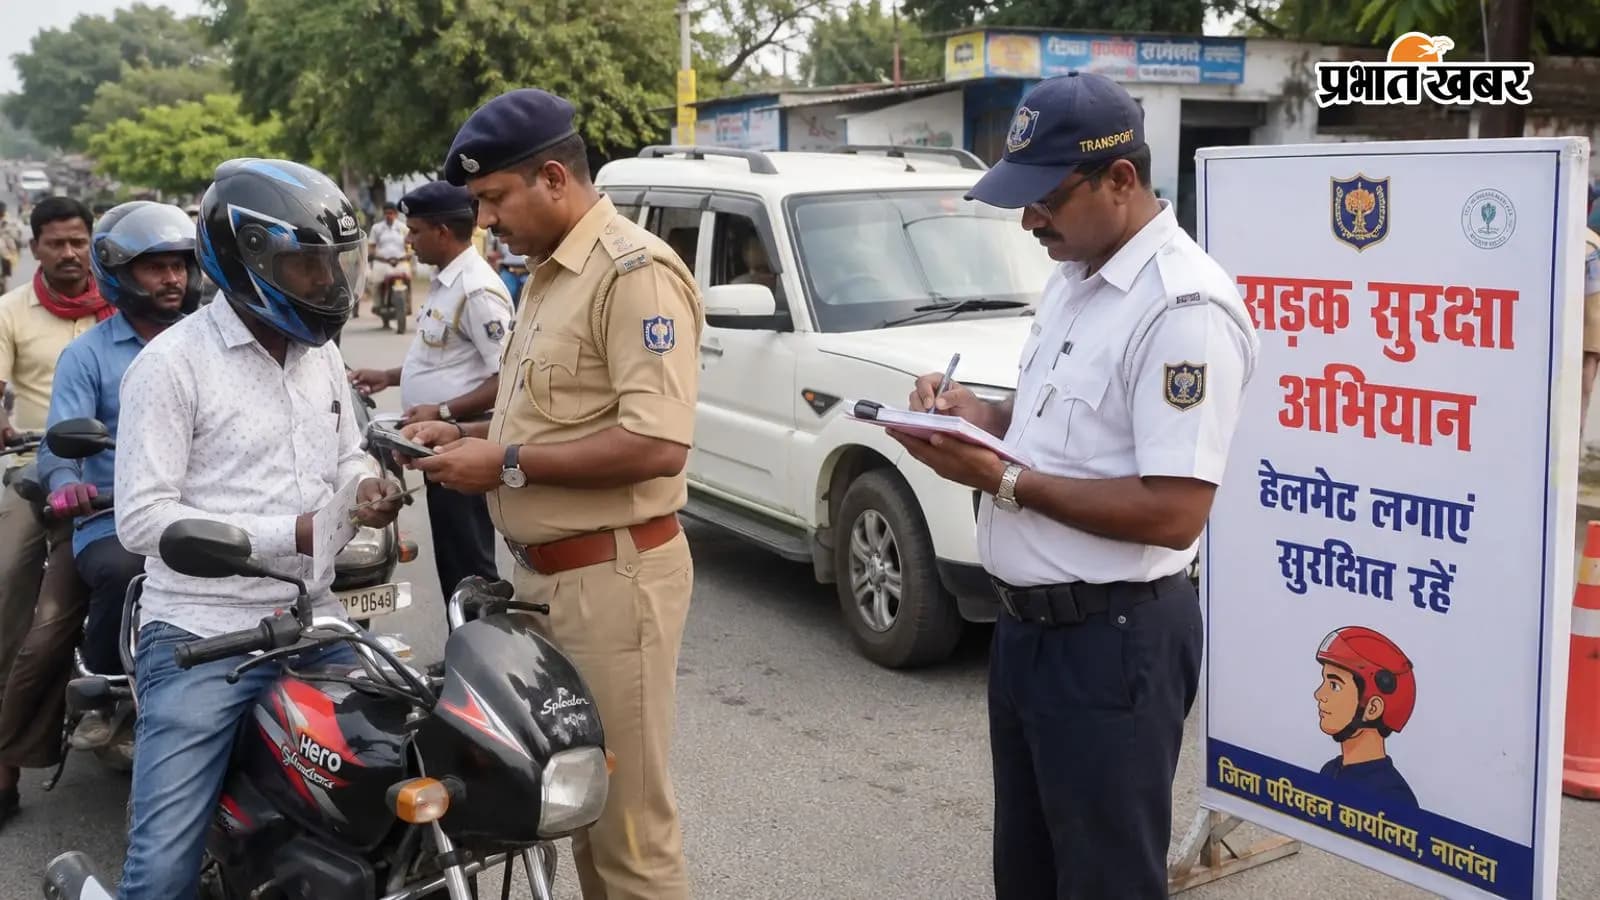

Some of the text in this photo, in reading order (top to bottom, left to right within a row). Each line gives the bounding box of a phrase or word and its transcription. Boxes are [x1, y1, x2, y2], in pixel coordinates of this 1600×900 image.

[1079, 129, 1134, 152] TRANSPORT
[1236, 275, 1520, 363] सड़क सुरक्षा
[1278, 362, 1477, 452] अभियान
[1258, 459, 1476, 544] हेलमेट लगाएं
[1276, 539, 1457, 614] सुरक्षित रहें
[300, 733, 342, 773] Hero
[1218, 757, 1498, 883] जिला परिवहन कार्यालय, नालंदा
